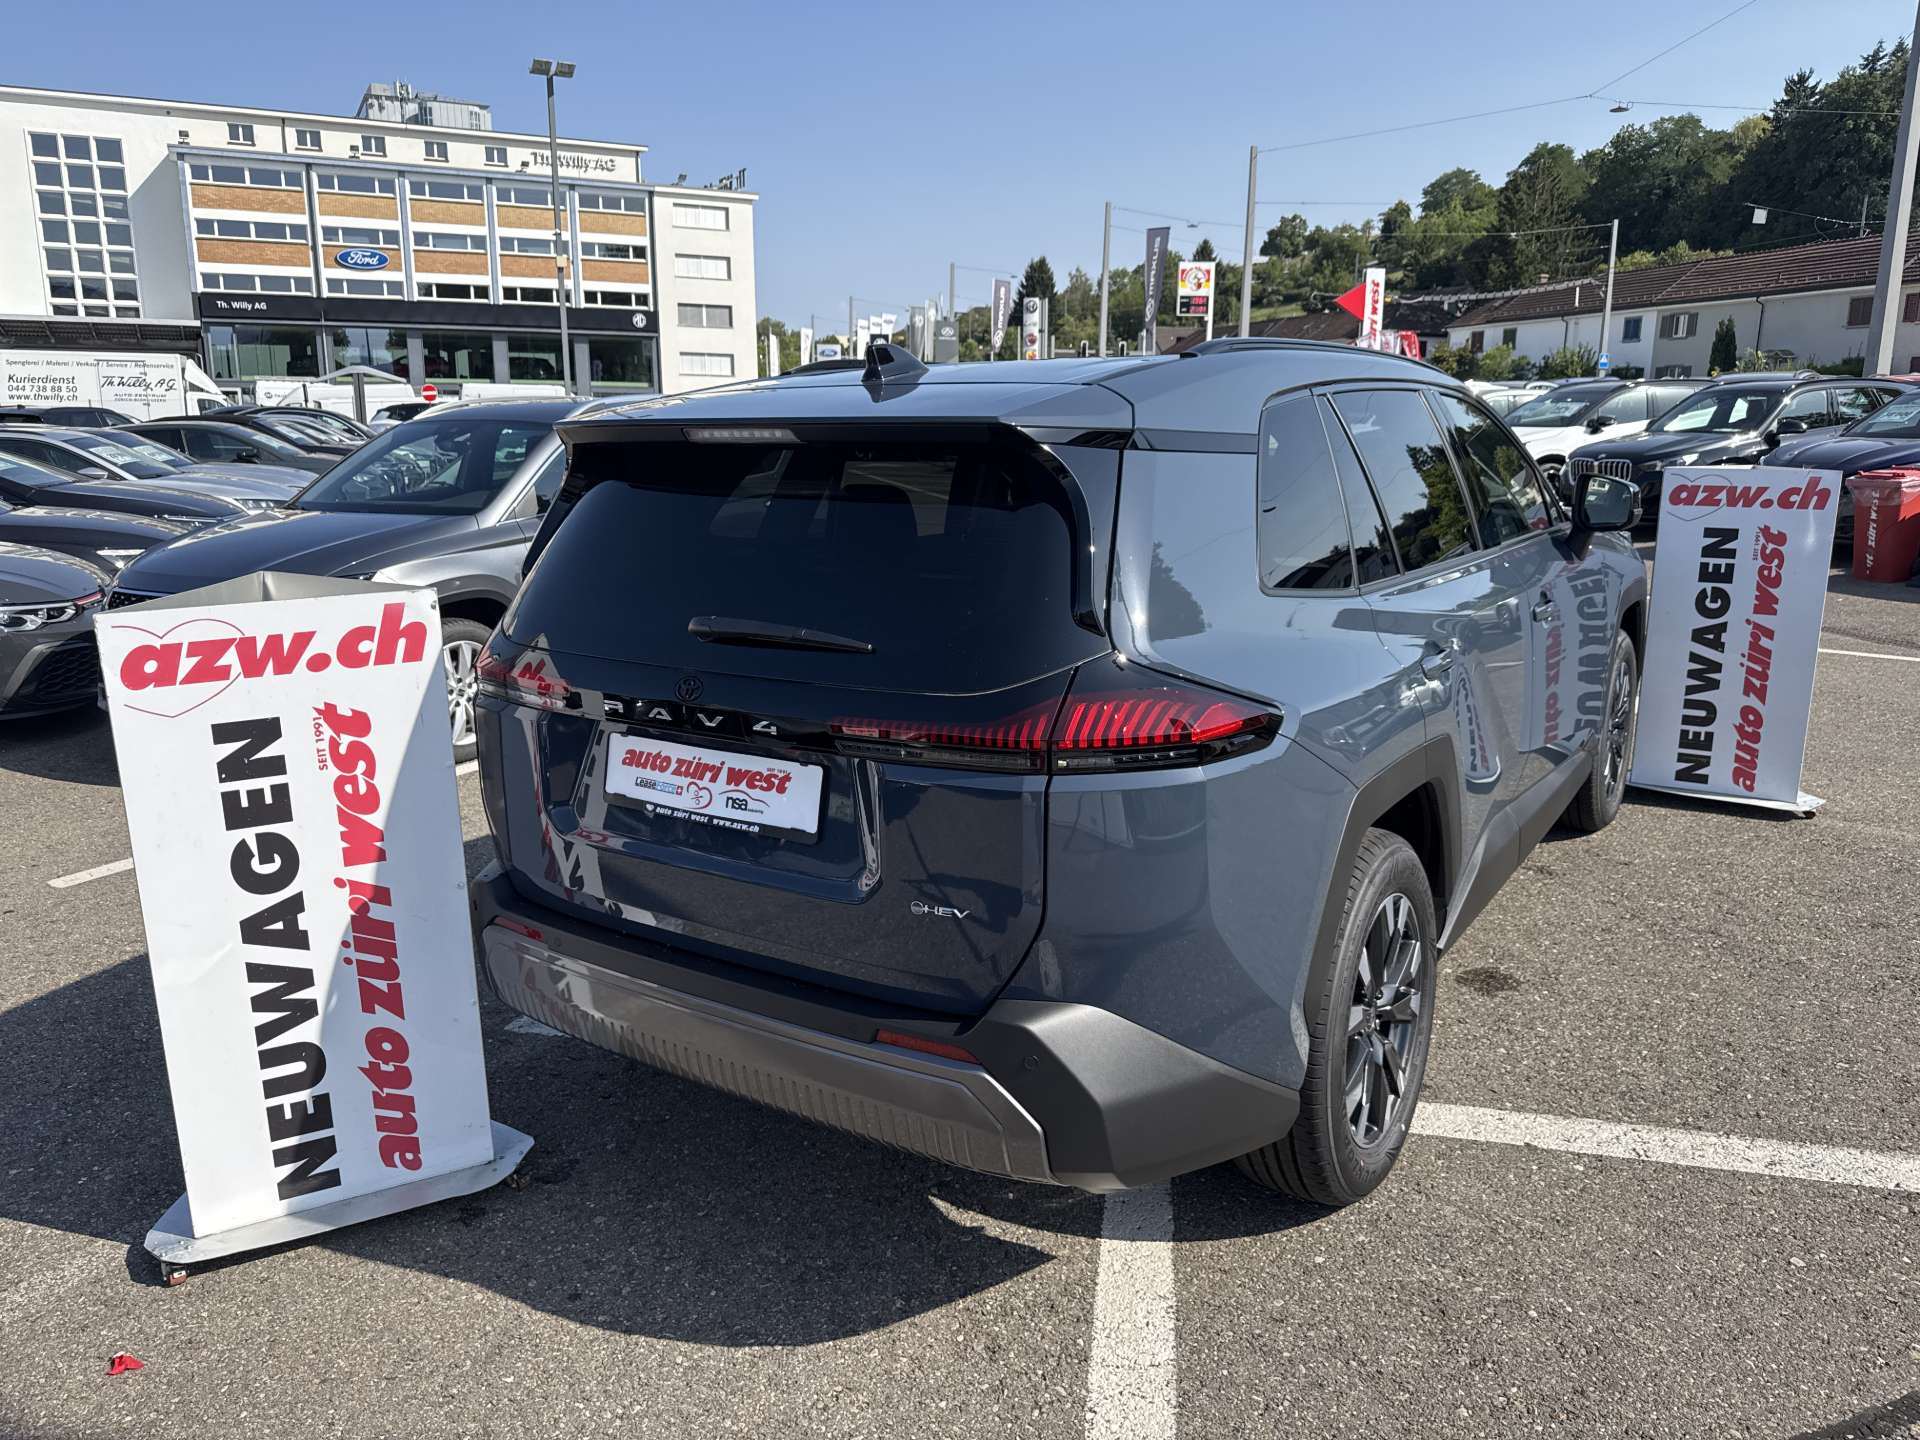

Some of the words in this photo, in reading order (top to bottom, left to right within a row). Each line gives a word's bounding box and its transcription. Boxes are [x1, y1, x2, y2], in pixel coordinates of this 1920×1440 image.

[347, 251, 379, 265] Ford
[1149, 236, 1161, 297] MAXUS
[216, 300, 229, 309] Th.
[231, 301, 252, 311] Willy
[254, 302, 267, 310] AG
[5, 359, 40, 367] Spenglerei
[7, 374, 76, 384] Kurierdienst
[7, 384, 27, 393] 044
[29, 384, 48, 393] 738
[50, 385, 63, 393] 88
[65, 385, 78, 393] 50
[8, 393, 78, 402] www.thwilly.ch
[117, 375, 154, 392] Willy
[154, 378, 178, 392] AG
[1669, 476, 1831, 511] azw.ch
[1752, 524, 1788, 616] west
[119, 601, 428, 692] azw.ch
[1674, 527, 1740, 785] NEUWAGEN
[1739, 618, 1776, 705] züri
[312, 716, 324, 744] 1991
[316, 747, 329, 772] SEIT
[1732, 705, 1763, 793] auto
[313, 701, 388, 868] west
[621, 749, 673, 774] auto
[671, 756, 726, 784] züri
[726, 765, 793, 795] west
[655, 806, 672, 816] auto
[690, 813, 709, 823] west
[712, 817, 760, 833] www.azw.ch
[725, 796, 749, 812] nsa
[211, 716, 342, 1201] NEUWAGEN
[332, 876, 407, 1022] züri
[356, 1028, 423, 1171] auto
